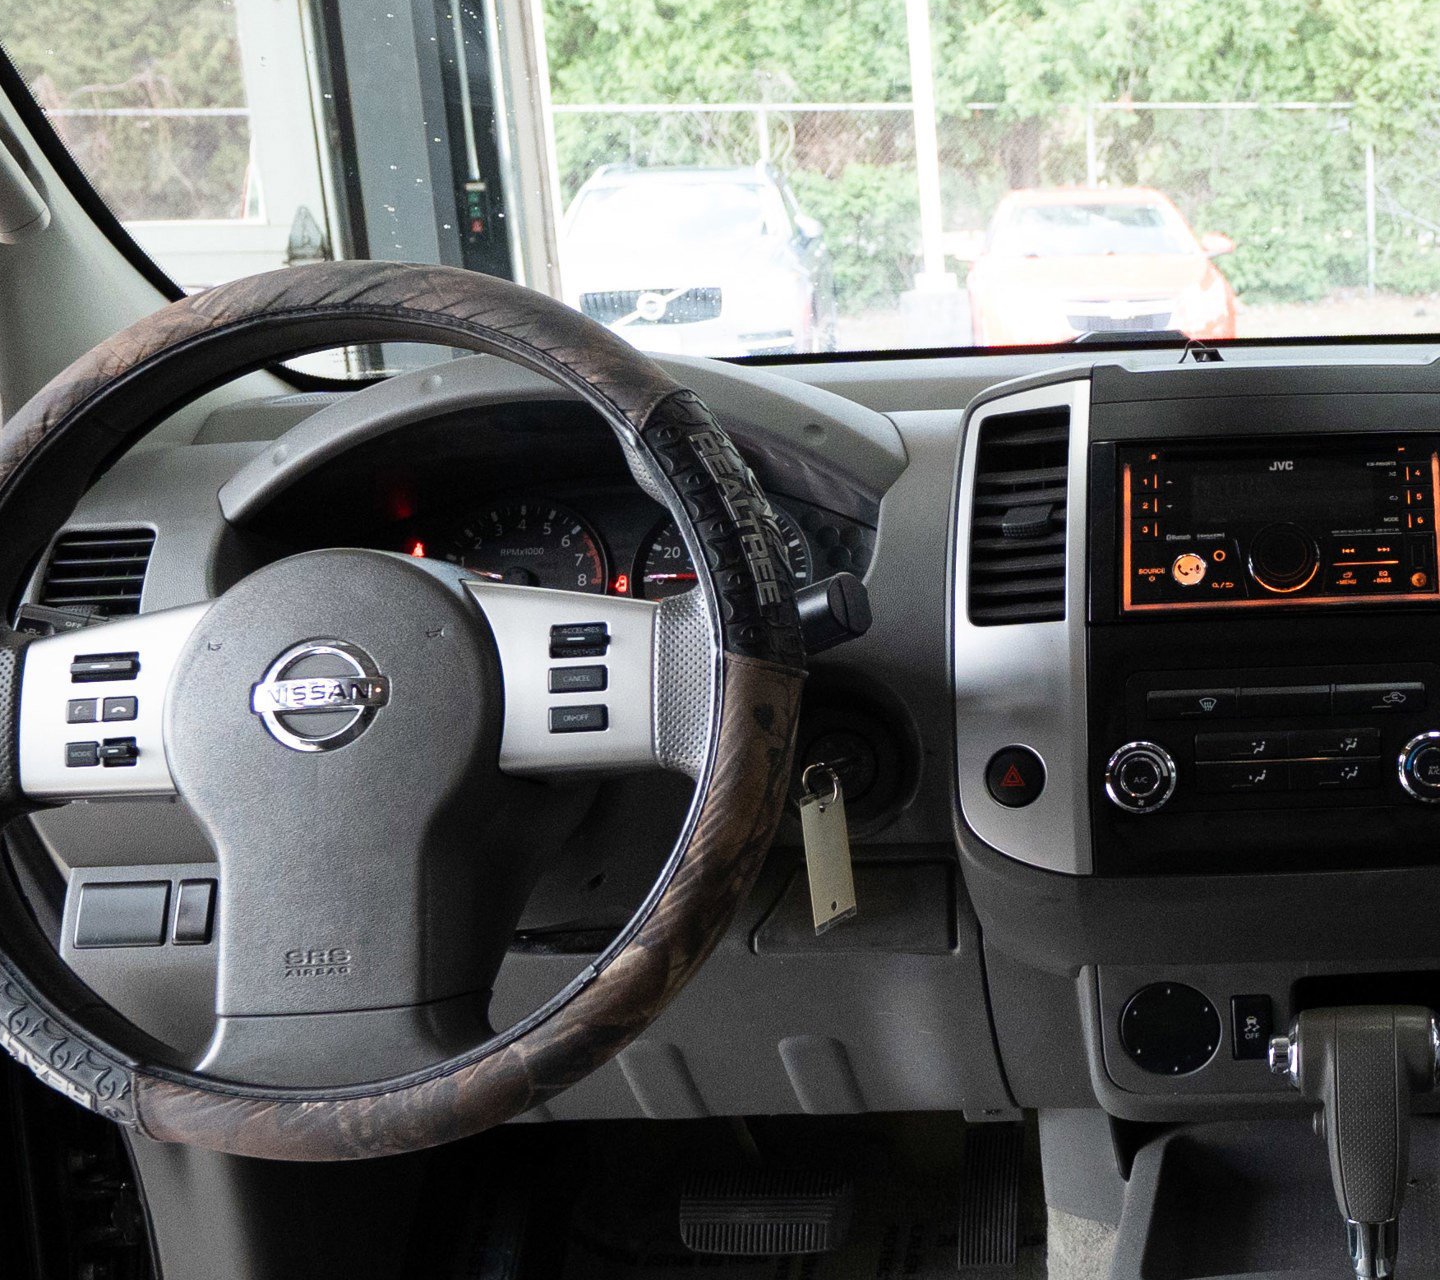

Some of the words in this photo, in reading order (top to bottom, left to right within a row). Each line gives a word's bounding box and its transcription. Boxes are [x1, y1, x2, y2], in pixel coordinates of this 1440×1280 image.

[1269, 460, 1294, 471] JVC
[1142, 477, 1148, 486] 1
[1416, 492, 1422, 501] 5
[1141, 501, 1149, 510] 2
[518, 517, 527, 531] 4
[689, 432, 781, 606] REALTREE
[1416, 516, 1424, 524] 6
[495, 523, 504, 537] 3
[542, 521, 552, 535] 5
[1141, 524, 1149, 534] 3
[473, 536, 482, 550] 2
[560, 534, 571, 548] 6
[500, 546, 545, 557] RPMx1000
[663, 546, 681, 559] 20
[574, 553, 584, 567] 7
[1138, 566, 1166, 575] SOURCE
[577, 572, 587, 587] 8
[65, 620, 83, 629] OFF
[563, 675, 591, 683] CANCEL
[268, 682, 373, 704] NISSAN
[1134, 776, 1147, 785] A/C
[284, 947, 351, 964] SRS
[284, 966, 350, 978] AIRBAG
[1244, 1032, 1260, 1040] OFF
